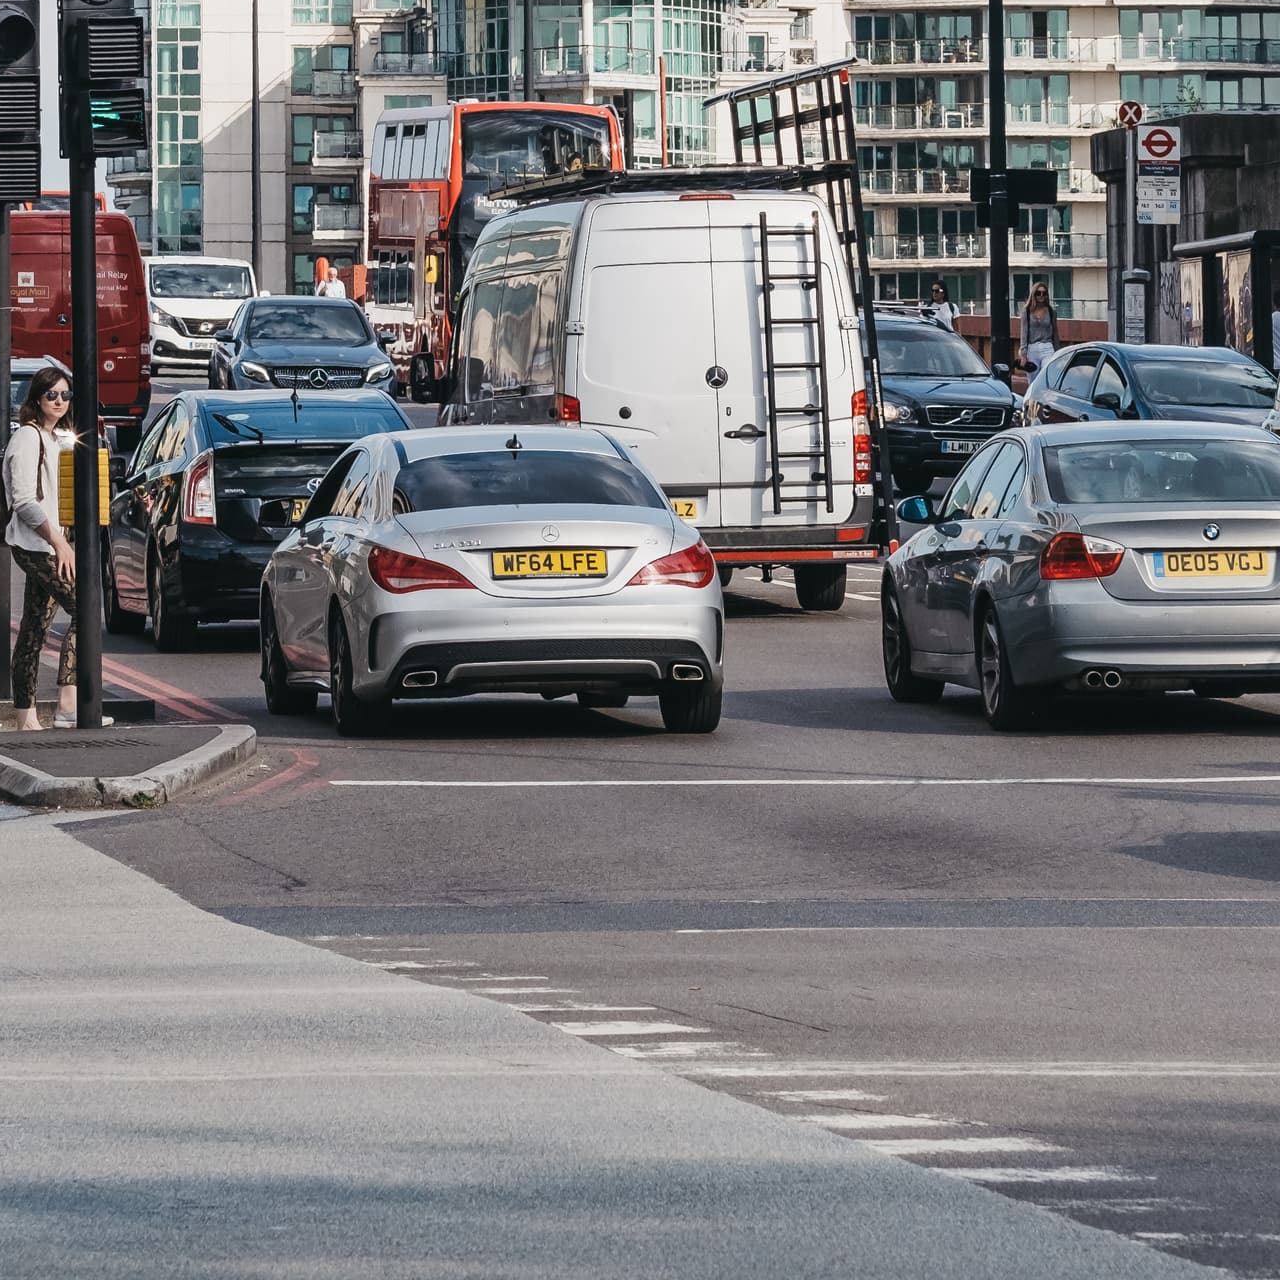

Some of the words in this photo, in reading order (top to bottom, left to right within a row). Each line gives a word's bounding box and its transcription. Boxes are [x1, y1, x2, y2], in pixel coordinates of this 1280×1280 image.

[1123, 104, 1138, 122] X
[503, 554, 554, 572] WF64
[559, 553, 598, 571] LFE
[1167, 554, 1218, 572] OE05
[1224, 553, 1263, 571] VGJ
